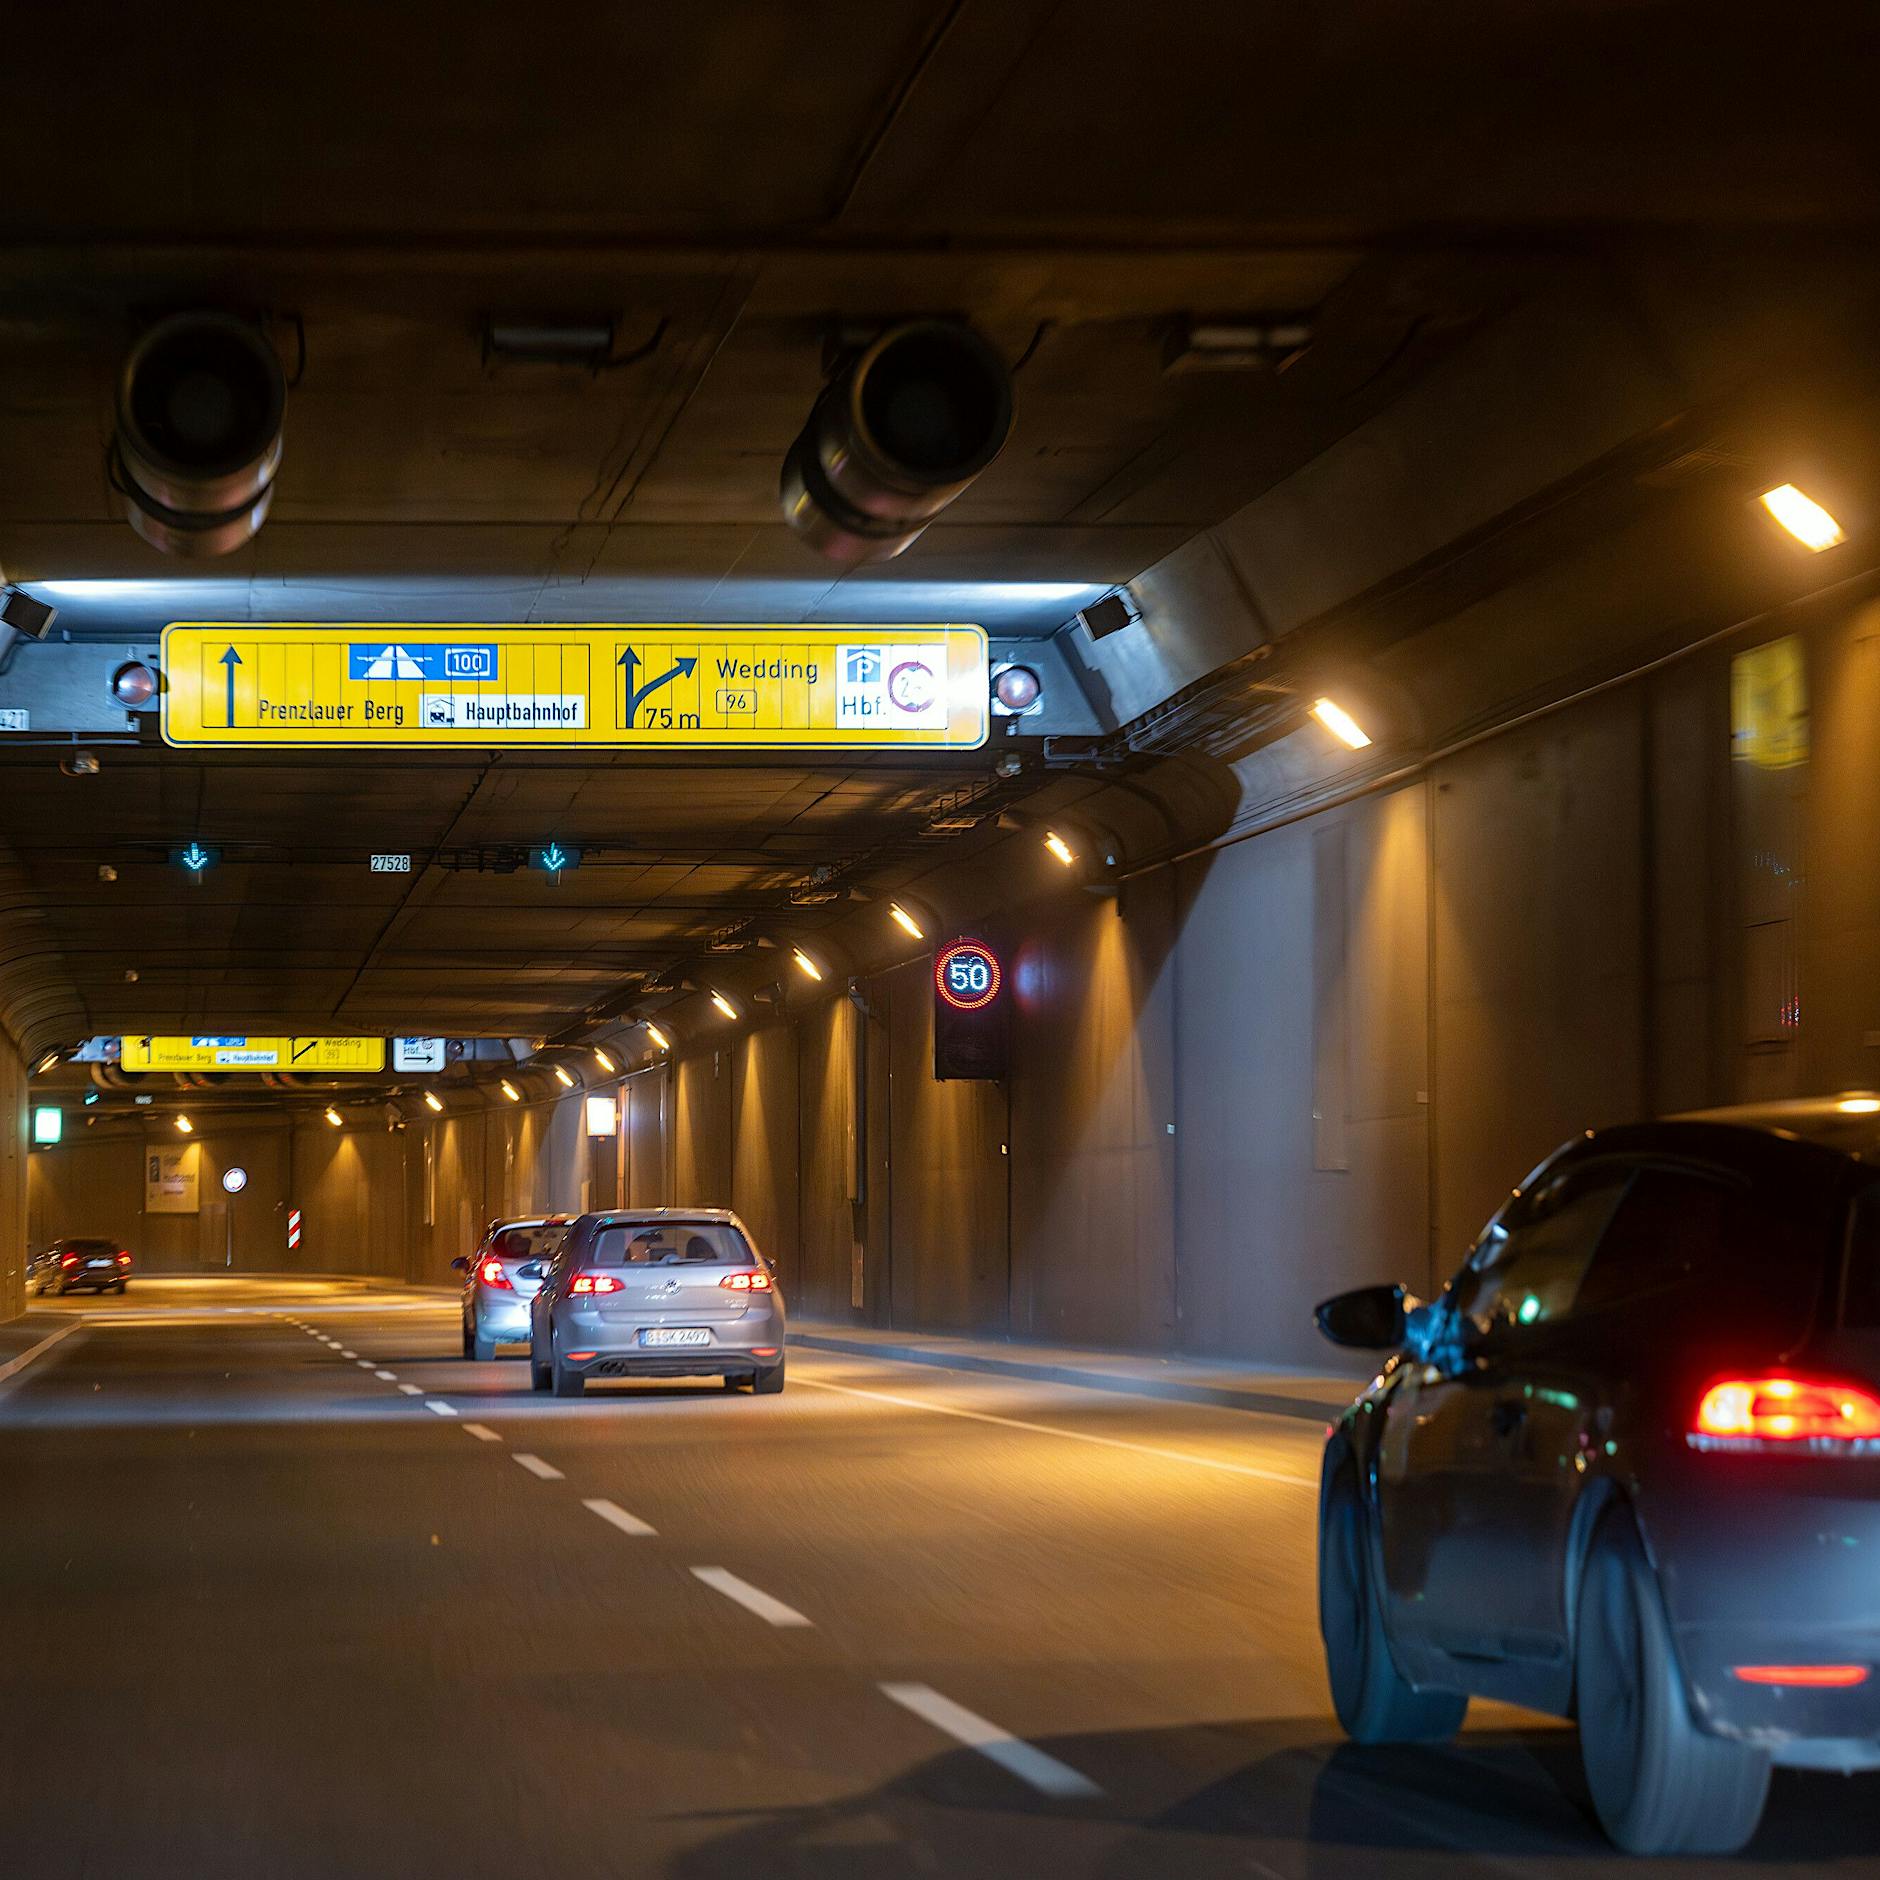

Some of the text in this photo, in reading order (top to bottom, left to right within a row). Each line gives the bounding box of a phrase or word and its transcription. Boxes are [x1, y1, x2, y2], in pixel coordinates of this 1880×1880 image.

[453, 652, 483, 671] 100
[716, 659, 818, 684] Wedding
[259, 700, 404, 725] Prenzlauer Berg
[726, 694, 746, 709] 96
[842, 694, 887, 716] Hbf.
[466, 701, 578, 726] Hauptbahnhof
[646, 708, 700, 729] 75 m
[372, 856, 409, 871] 27528
[951, 960, 988, 990] 50
